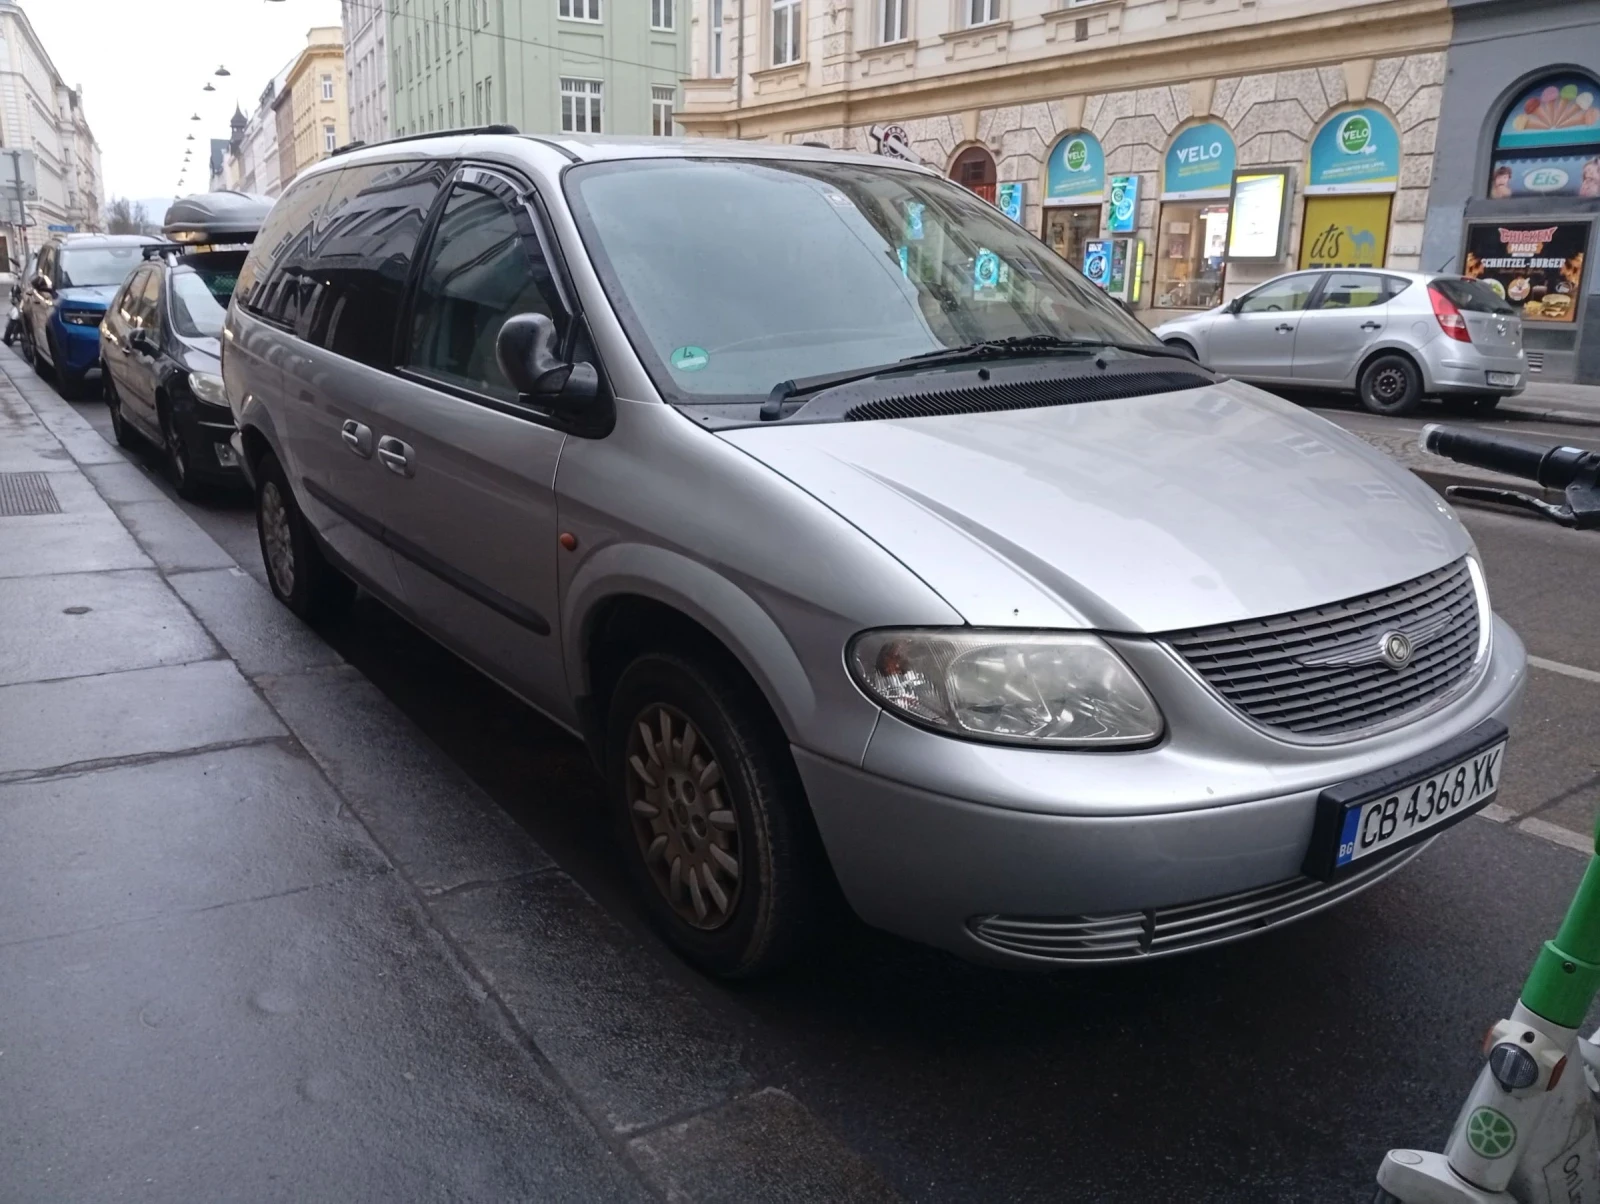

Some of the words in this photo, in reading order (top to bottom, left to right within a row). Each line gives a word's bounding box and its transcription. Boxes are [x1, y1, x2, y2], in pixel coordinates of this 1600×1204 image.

[1343, 128, 1369, 140] VELO
[1176, 142, 1222, 163] VELO
[1533, 172, 1560, 186] Eis
[1310, 223, 1345, 259] it's
[1498, 226, 1558, 243] CHICKEN
[1510, 243, 1539, 252] HAUS
[1361, 796, 1399, 849] CB
[1403, 766, 1467, 828] 4368
[1468, 748, 1500, 801] XK
[1338, 841, 1354, 858] BG
